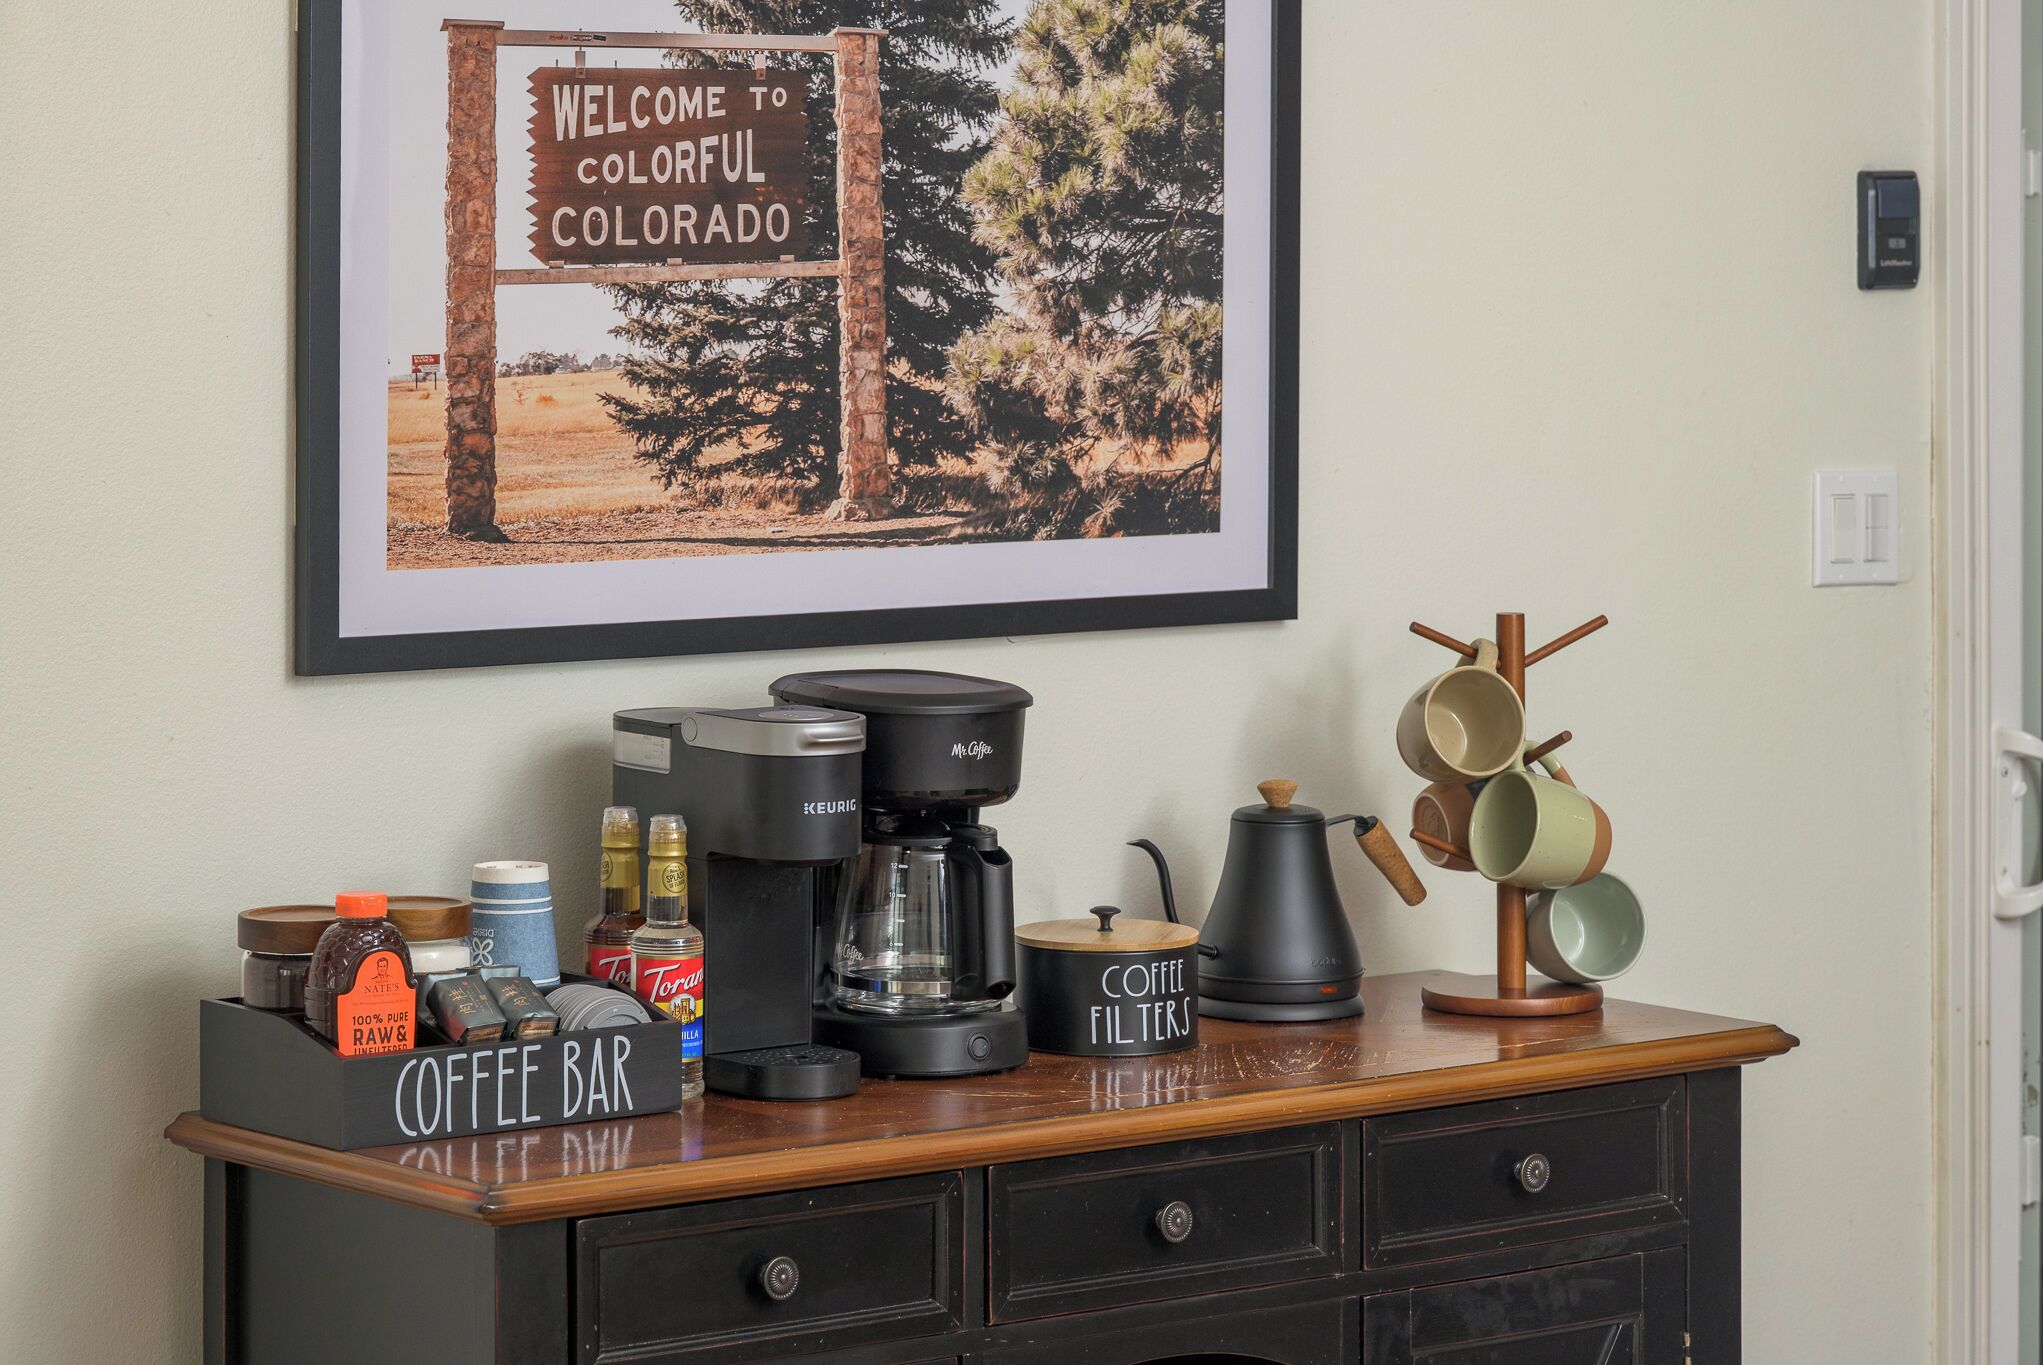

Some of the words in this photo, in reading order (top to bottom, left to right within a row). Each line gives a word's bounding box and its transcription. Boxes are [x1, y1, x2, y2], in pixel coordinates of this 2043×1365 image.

[552, 84, 726, 142] WELCOME
[750, 86, 787, 110] TO
[577, 129, 765, 184] COLORFUL
[551, 203, 790, 246] COLORADO
[967, 740, 994, 760] Coffee
[803, 798, 857, 815] KEURIG
[364, 982, 401, 994] NATE'S
[1102, 958, 1185, 998] COFFEE
[352, 1013, 384, 1026] 100%
[387, 1011, 409, 1024] PURE
[353, 1025, 394, 1046] RAW
[396, 1024, 408, 1042] &
[1090, 996, 1190, 1045] FILTERS
[395, 1044, 542, 1137] COFFEE
[563, 1035, 634, 1119] BAR
